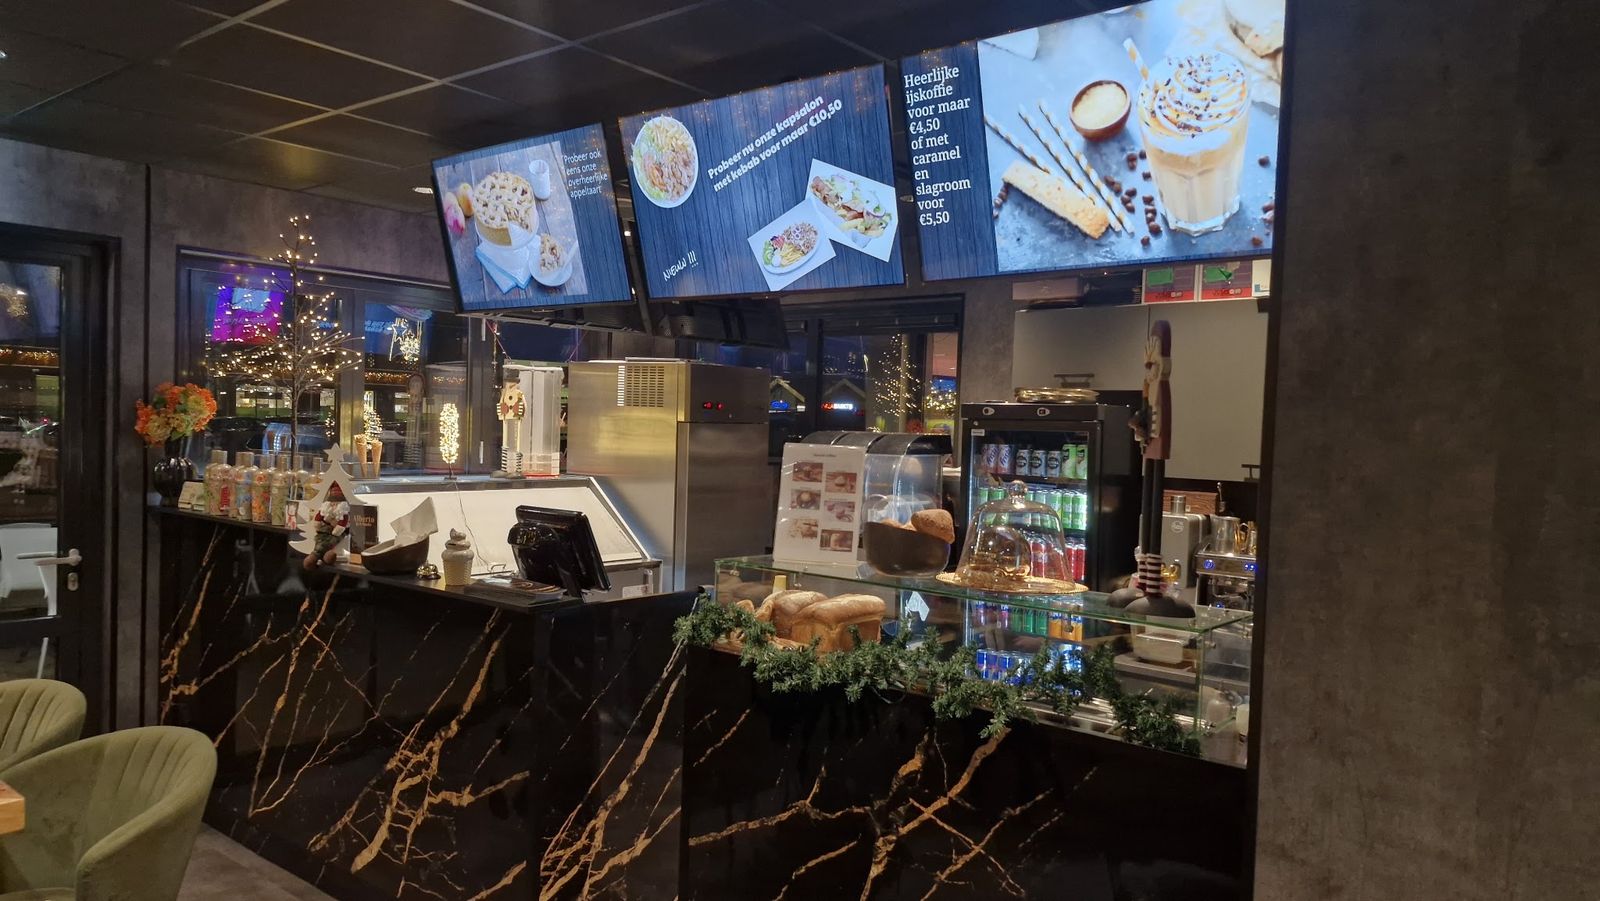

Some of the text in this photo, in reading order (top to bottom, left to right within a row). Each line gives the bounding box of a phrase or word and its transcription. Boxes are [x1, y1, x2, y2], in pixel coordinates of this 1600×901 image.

[904, 66, 960, 88] Heerlijke
[906, 83, 953, 107] ijskoffie
[907, 97, 971, 119] voor maar
[909, 117, 940, 135] €4,50
[708, 96, 824, 179] Probeer nu onze kapsalon
[713, 99, 842, 192] met kebab voor maar €10,50
[911, 132, 950, 150] of met
[563, 147, 602, 165] Probeer ook
[913, 145, 961, 165] caramel
[566, 163, 597, 176] eens onze
[914, 169, 930, 180] en
[568, 171, 608, 187] overheerlijke
[916, 178, 972, 197] slagroom
[570, 185, 602, 200] appeltaart
[917, 198, 945, 211] voor
[919, 211, 950, 227] €5,50
[662, 257, 687, 282] NIEUW
